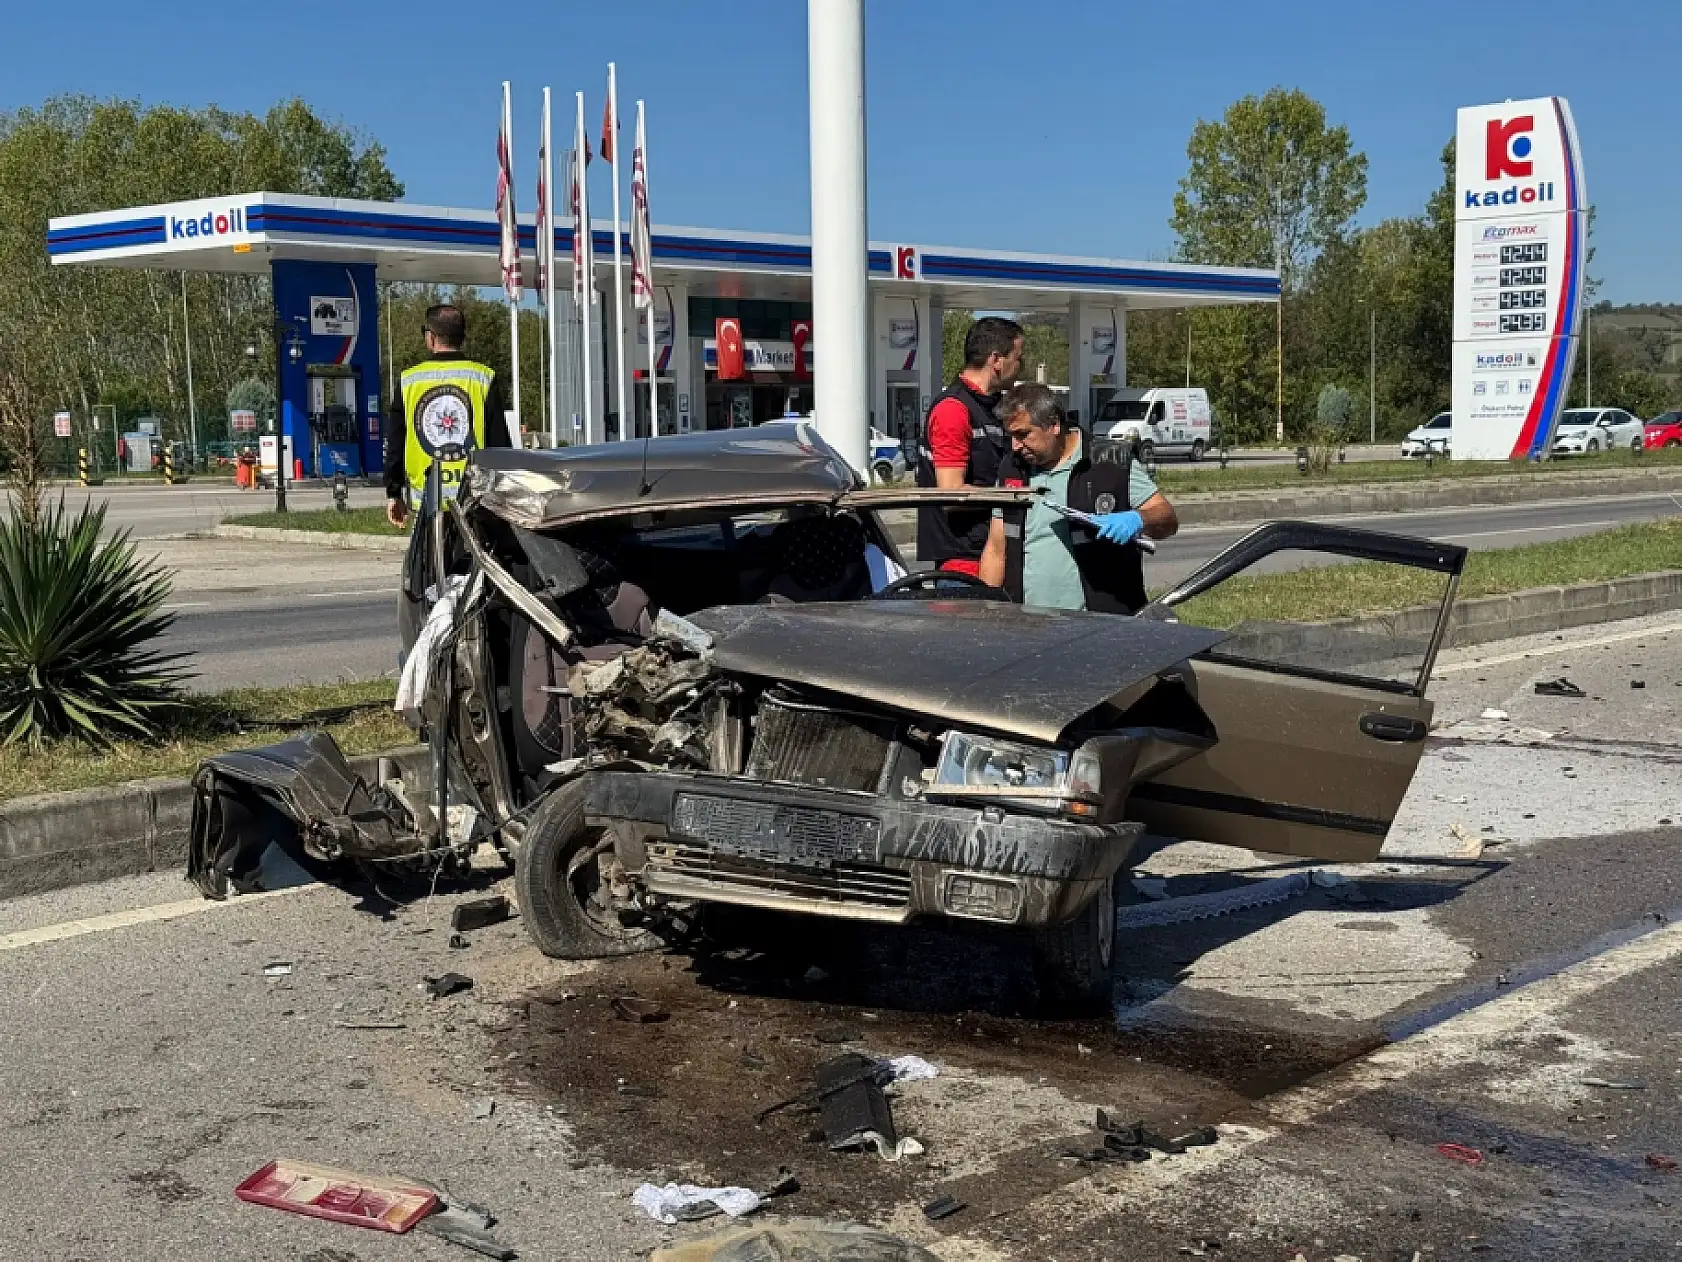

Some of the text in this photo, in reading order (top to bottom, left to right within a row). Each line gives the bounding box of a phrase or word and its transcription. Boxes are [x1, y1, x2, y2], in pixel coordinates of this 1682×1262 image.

[1465, 182, 1553, 208] kadoil
[171, 207, 242, 239] kadoil
[1477, 353, 1522, 363] kadoil
